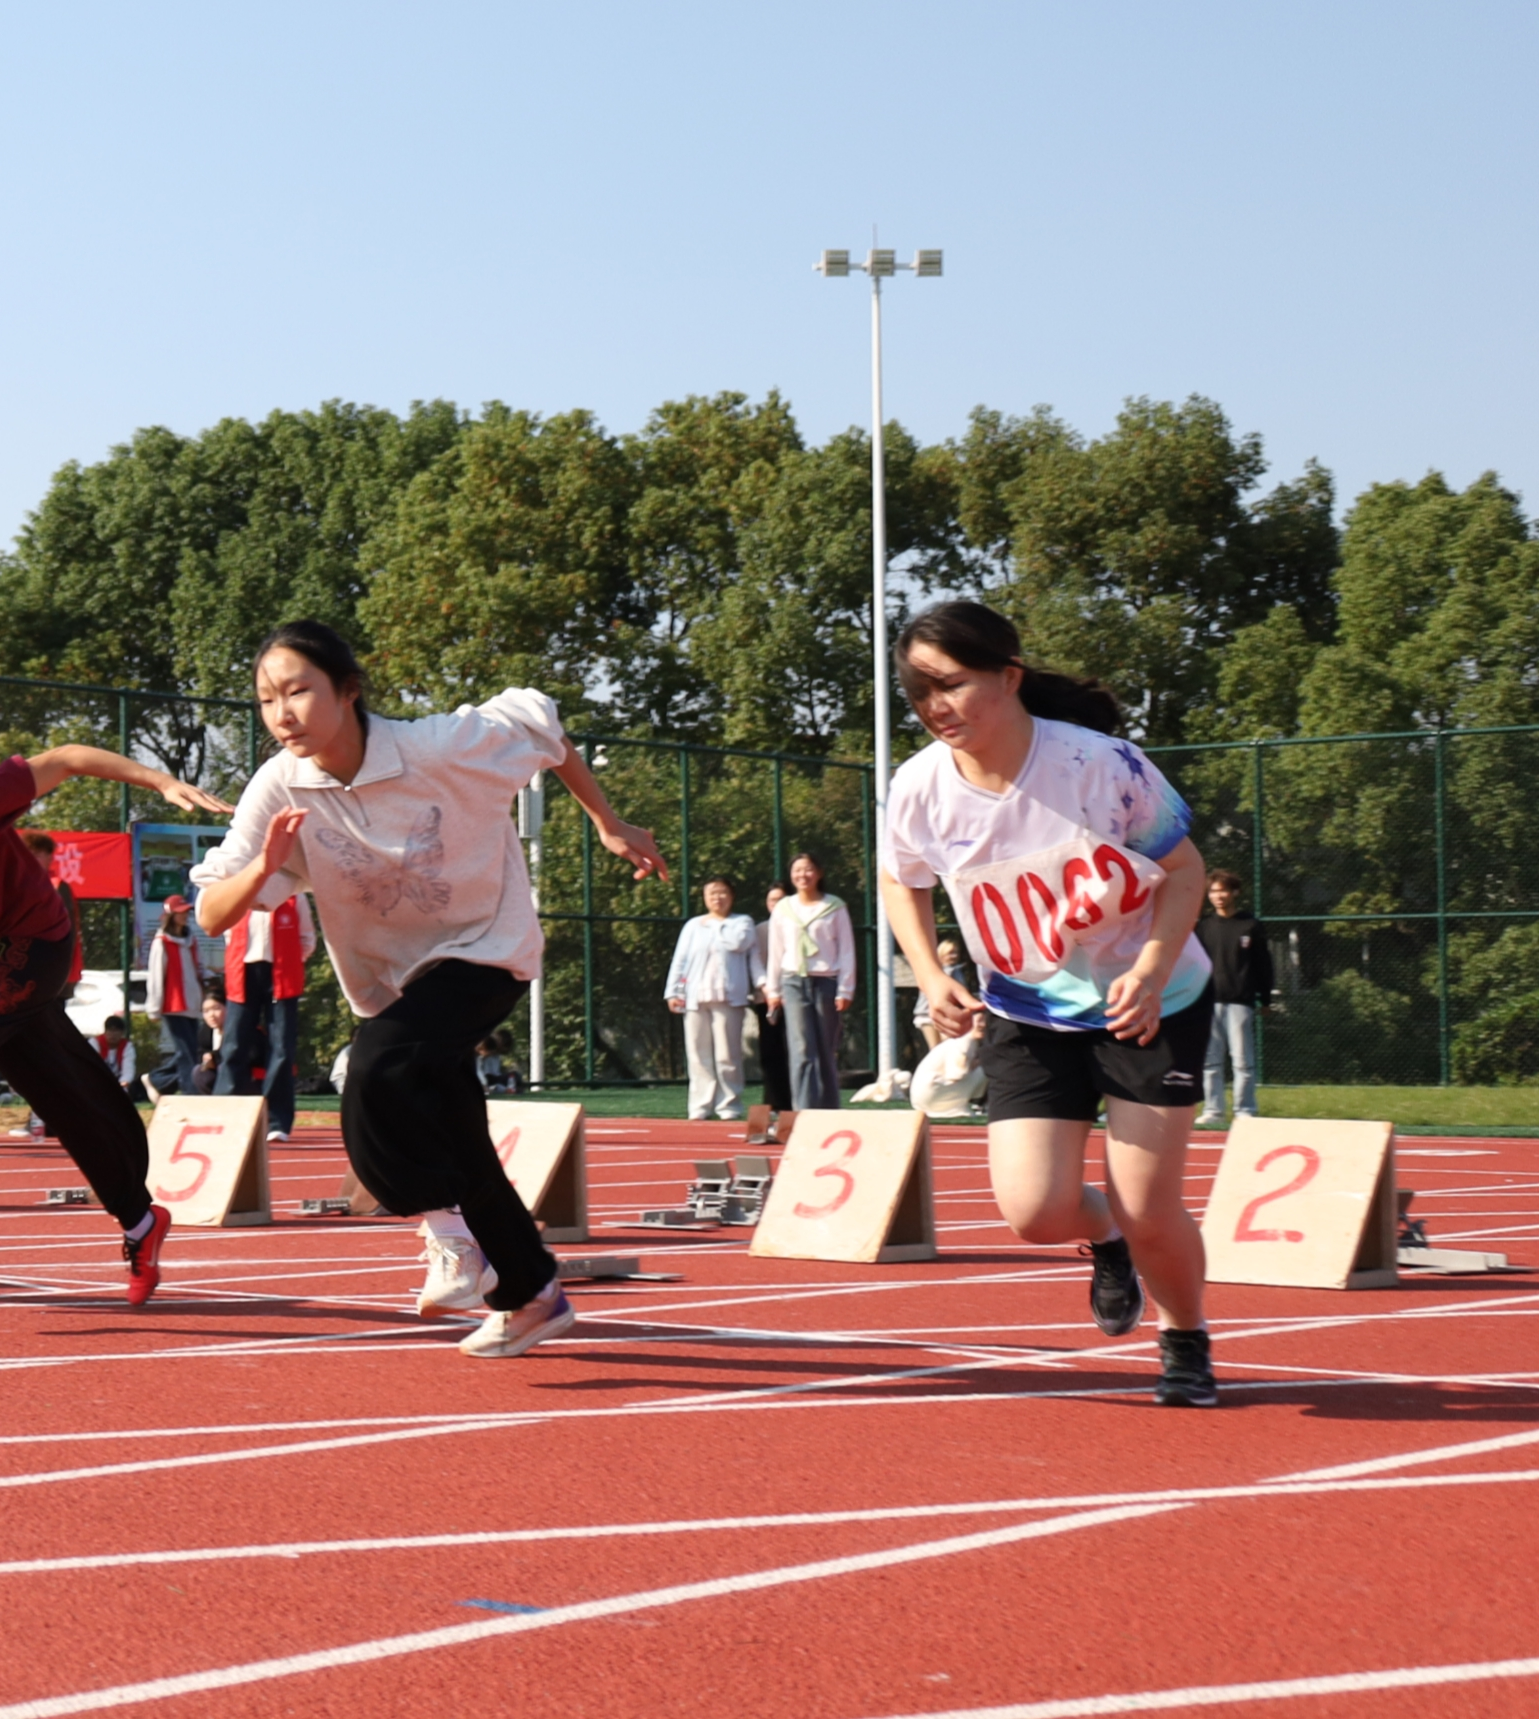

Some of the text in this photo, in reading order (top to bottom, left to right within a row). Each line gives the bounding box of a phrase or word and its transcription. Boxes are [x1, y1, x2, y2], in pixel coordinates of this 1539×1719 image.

[971, 843, 1151, 976] 0062
[155, 1125, 224, 1202] 5
[792, 1130, 862, 1219] 3
[1232, 1145, 1322, 1243] 2
